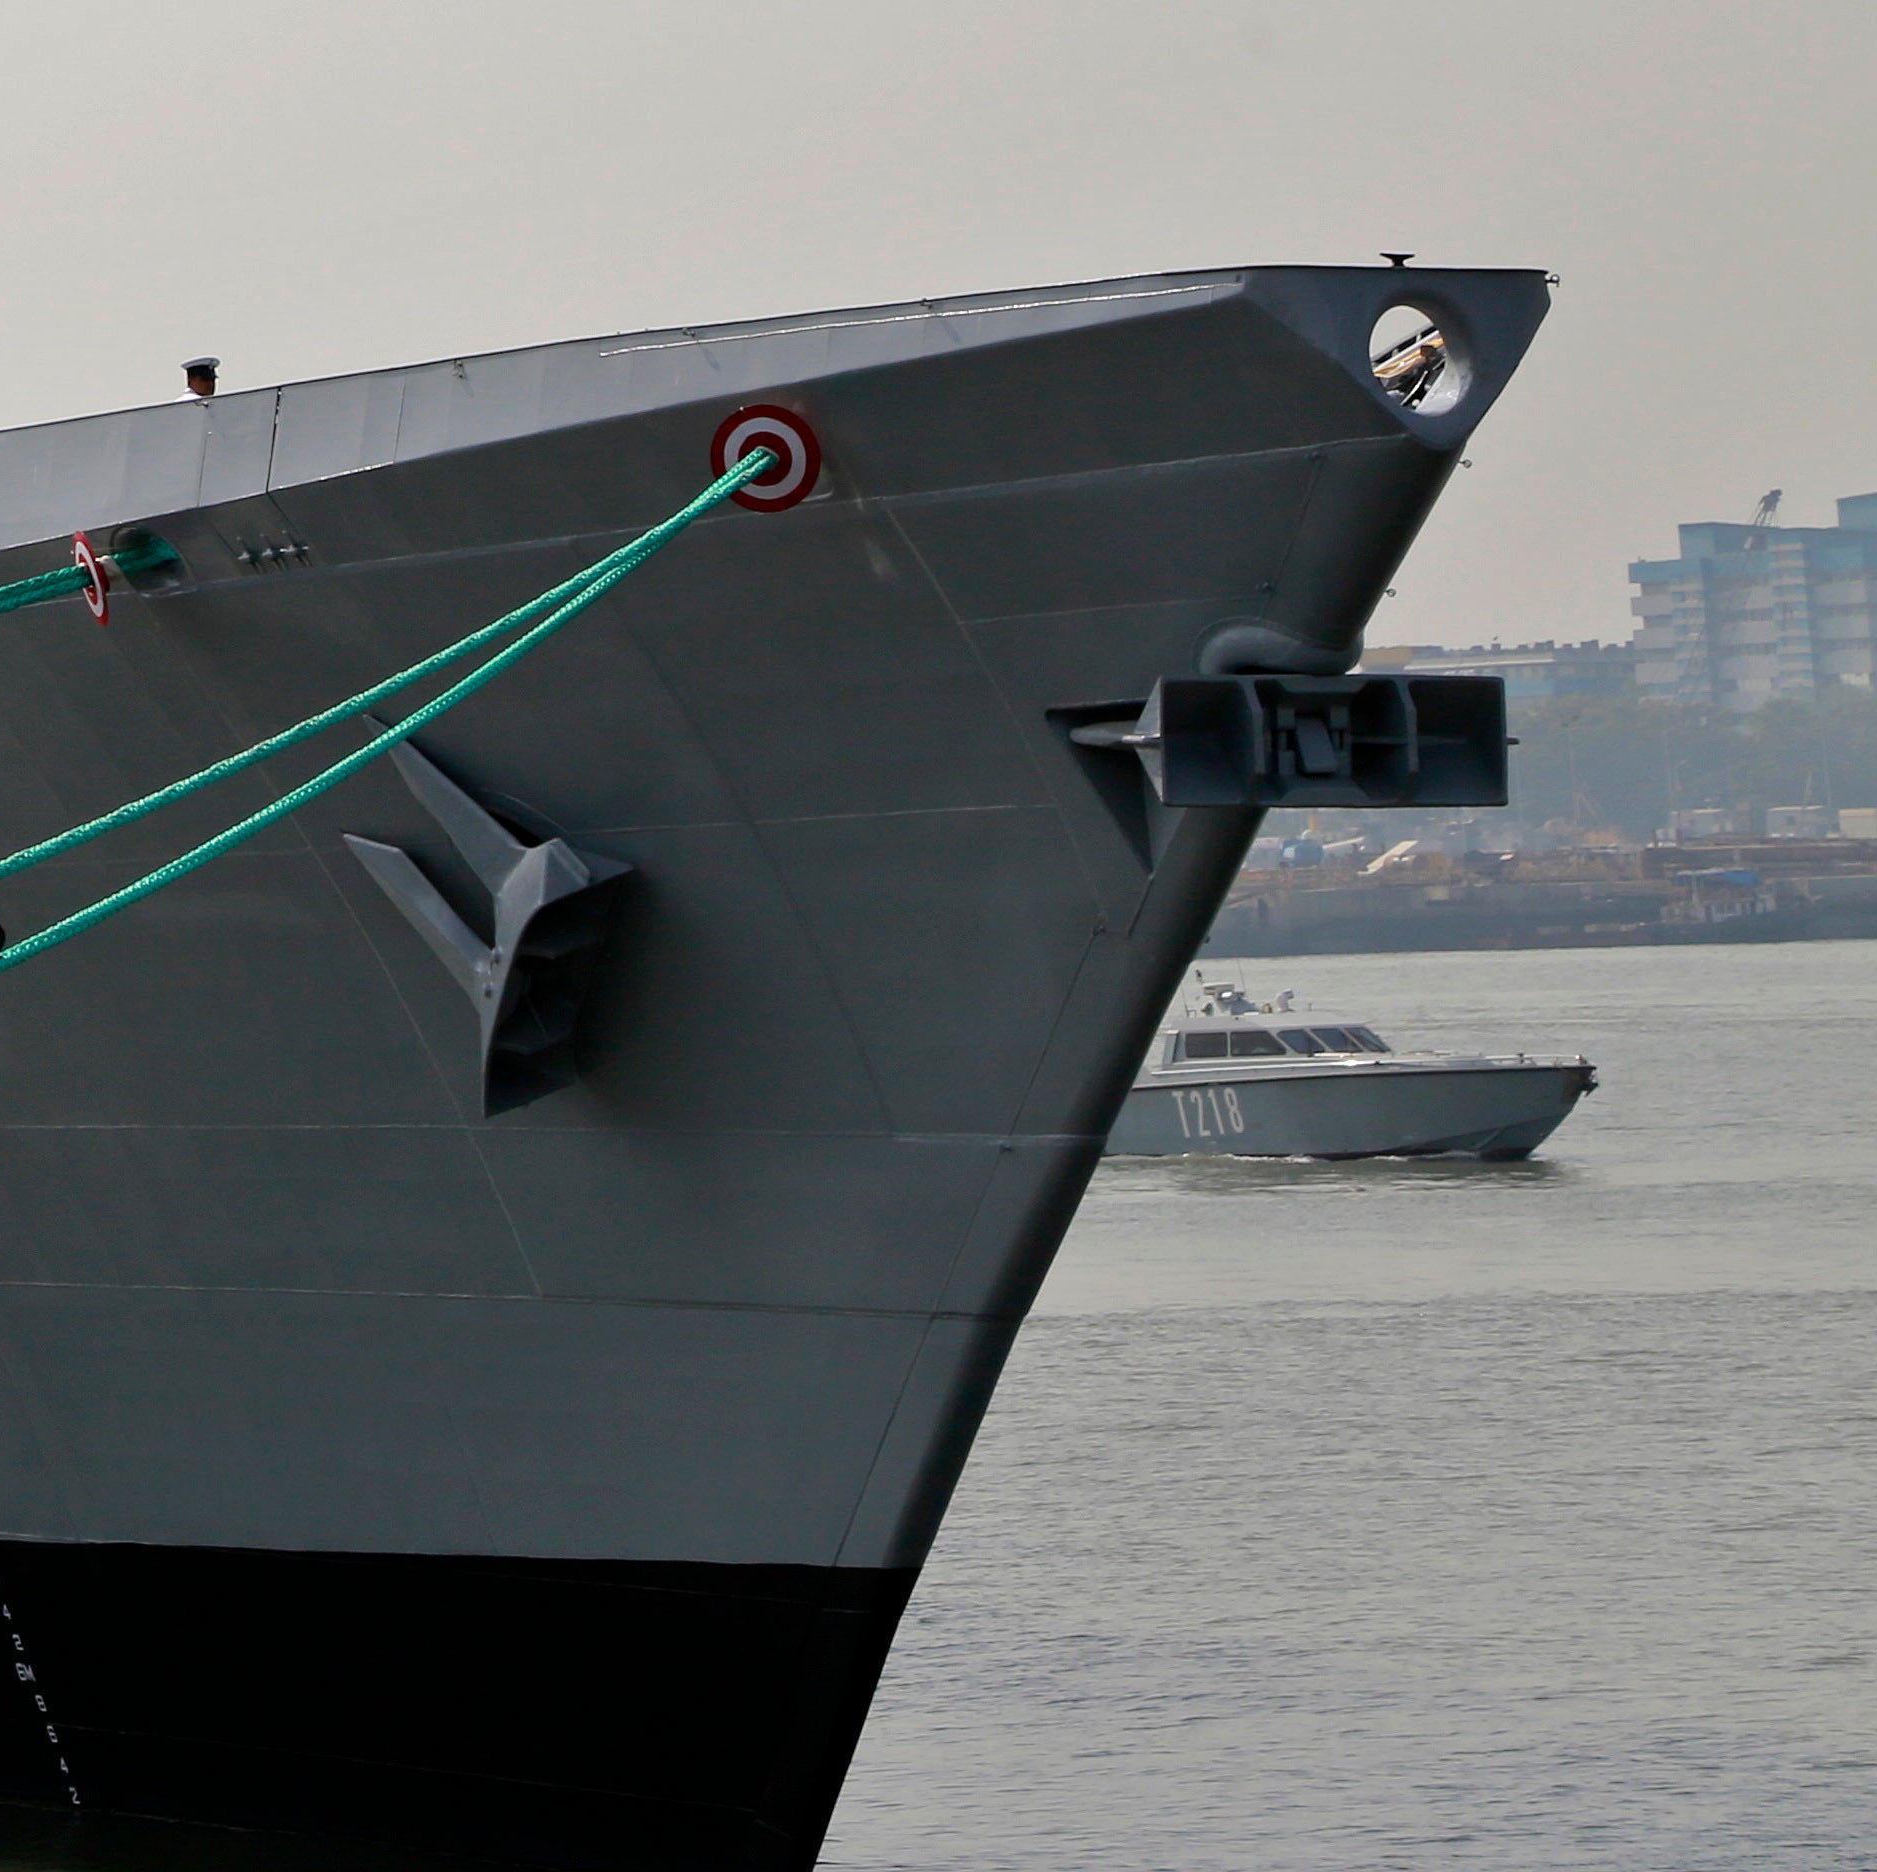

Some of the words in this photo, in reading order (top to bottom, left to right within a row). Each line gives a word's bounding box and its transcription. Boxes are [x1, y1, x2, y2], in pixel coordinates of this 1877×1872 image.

[1172, 1087, 1244, 1138] T218
[3, 1604, 12, 1620] 4
[12, 1634, 24, 1651] 2
[35, 1695, 47, 1712] 8
